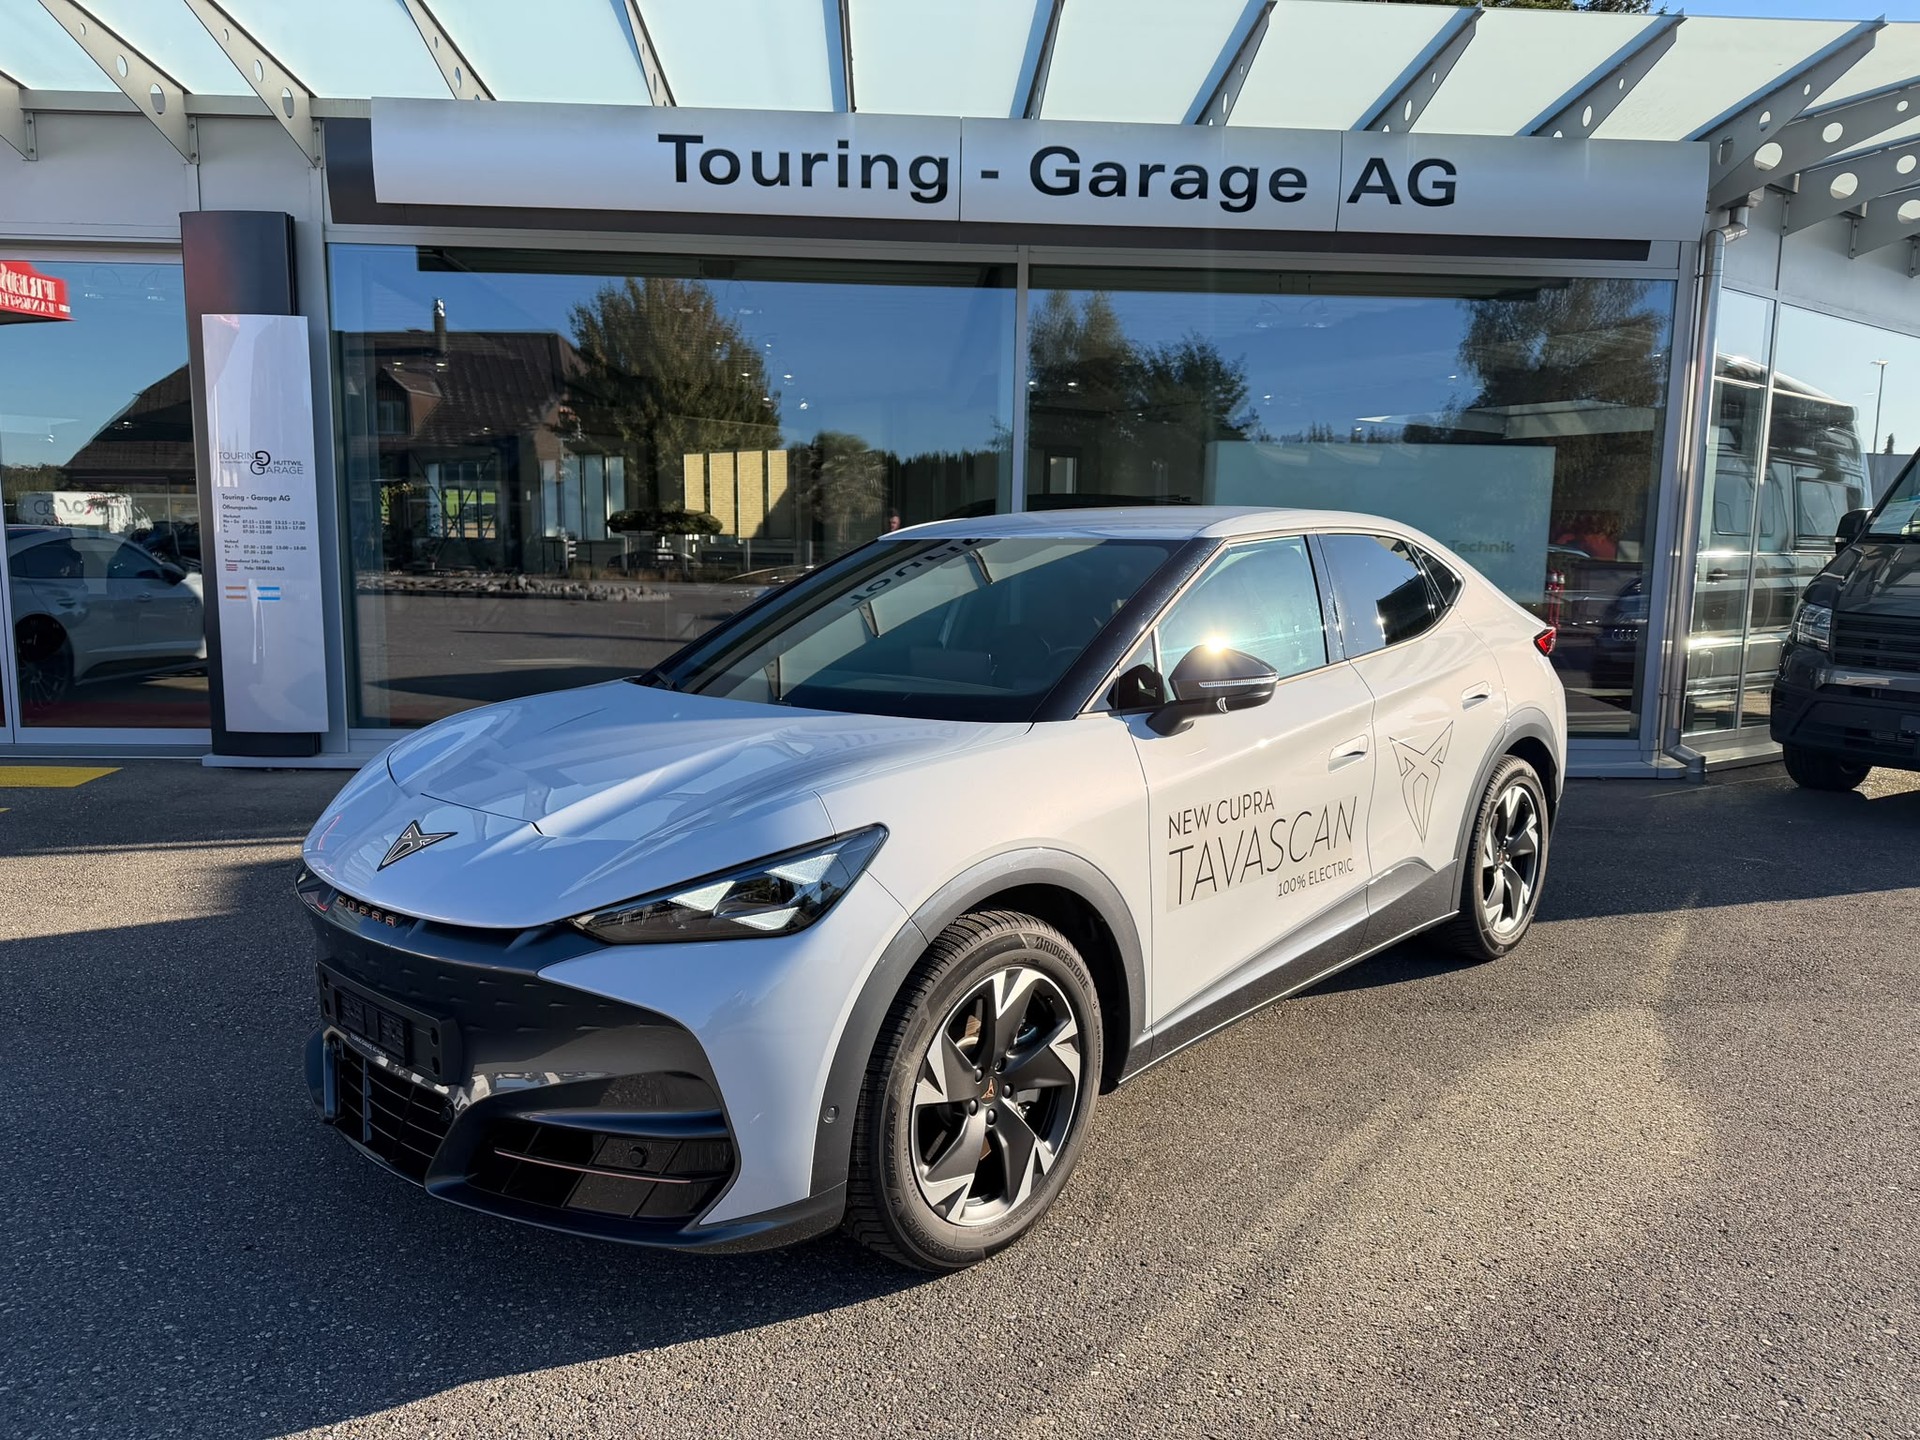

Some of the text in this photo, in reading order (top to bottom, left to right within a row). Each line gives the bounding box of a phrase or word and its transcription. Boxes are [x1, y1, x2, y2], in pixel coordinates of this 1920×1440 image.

[658, 133, 1458, 213] Touring - Garage AG
[221, 493, 245, 501] Touring
[250, 494, 277, 502] Garage
[1449, 540, 1515, 553] Technik
[1168, 788, 1275, 839] NEW CUPRA
[1169, 796, 1357, 905] TAVASCAN
[1278, 858, 1354, 897] 100% ELECTRIC
[1034, 936, 1089, 991] BRIDGESTONE
